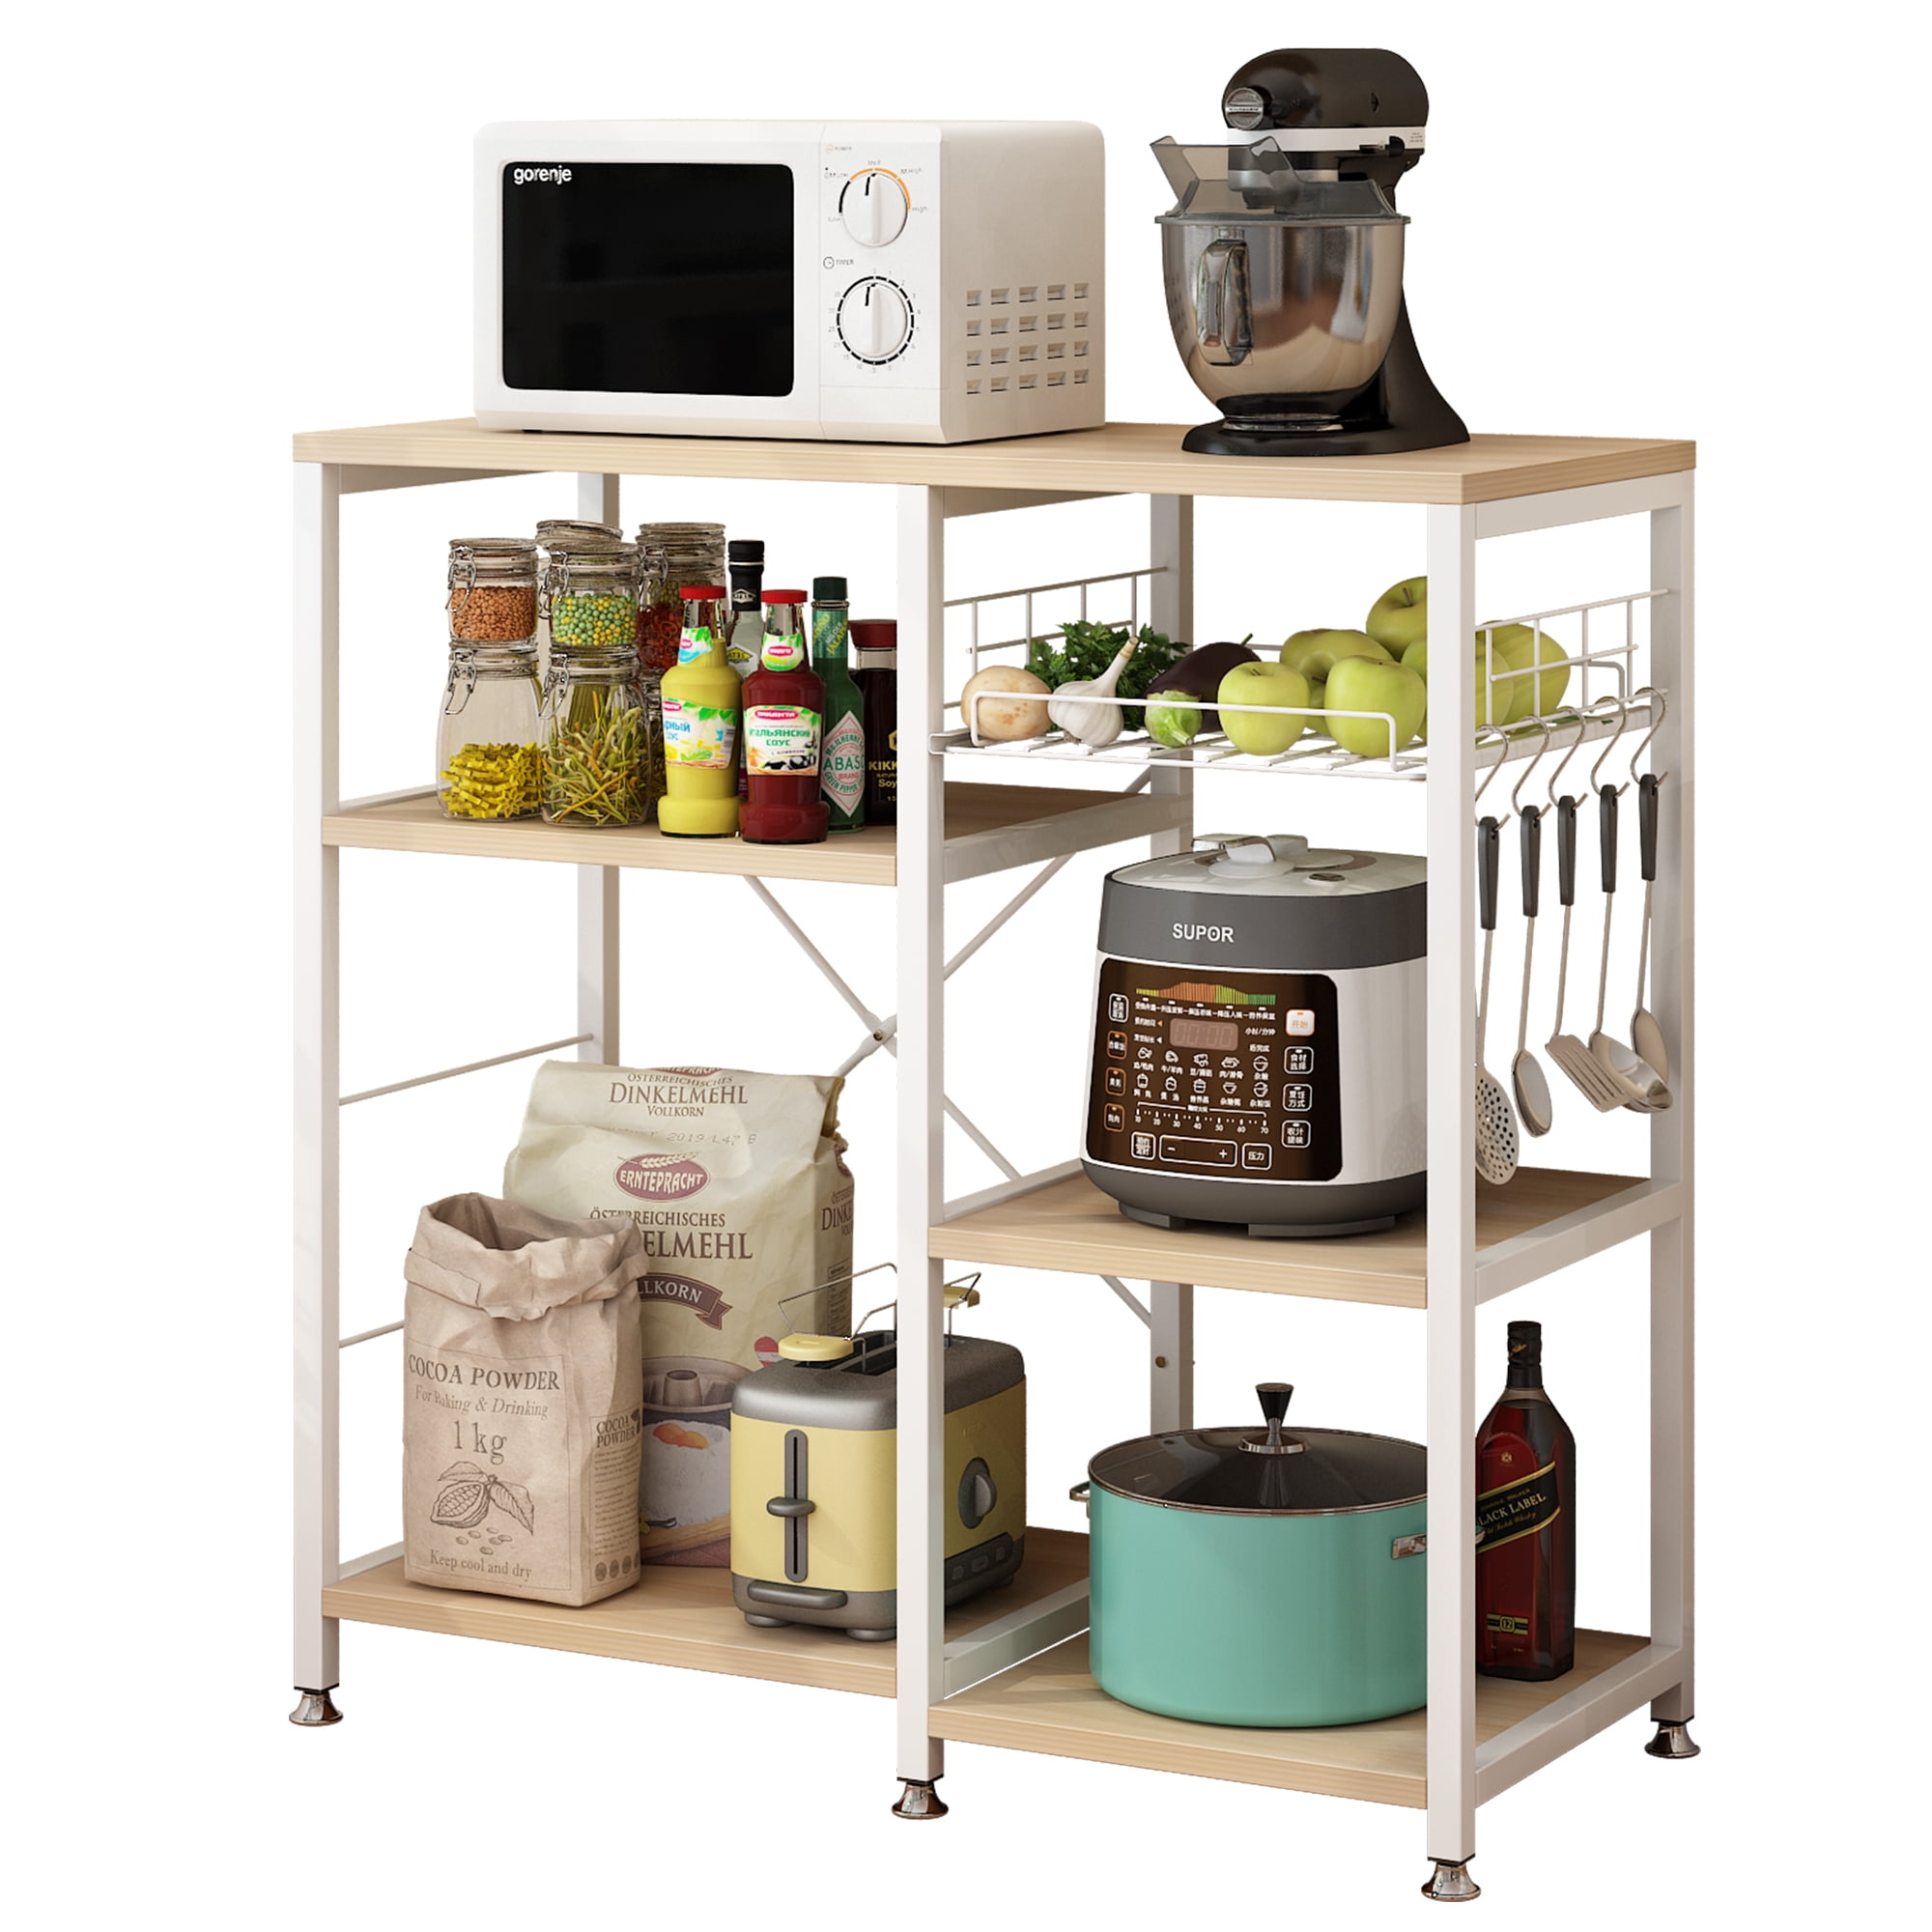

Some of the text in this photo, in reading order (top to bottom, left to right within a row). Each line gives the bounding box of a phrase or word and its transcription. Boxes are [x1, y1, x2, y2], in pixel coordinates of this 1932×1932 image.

[513, 164, 573, 185] gorenje
[1172, 923, 1235, 943] SUPOR
[610, 1082, 749, 1104] DINKELMEHL
[647, 1105, 705, 1117] VOLLKORN
[667, 1132, 705, 1143] 2019
[1248, 1151, 1264, 1161] 压力
[620, 1170, 704, 1194] ERNTEPRACHT
[409, 1354, 560, 1390] COCOA POWDER
[415, 1384, 549, 1420] For Baking & Drinking
[596, 1414, 630, 1435] COCOA
[454, 1420, 508, 1466] 1 kg
[596, 1427, 636, 1449] POWDER
[1476, 1493, 1546, 1527] LACK LABEL
[430, 1549, 532, 1582] Keep cool and dry
